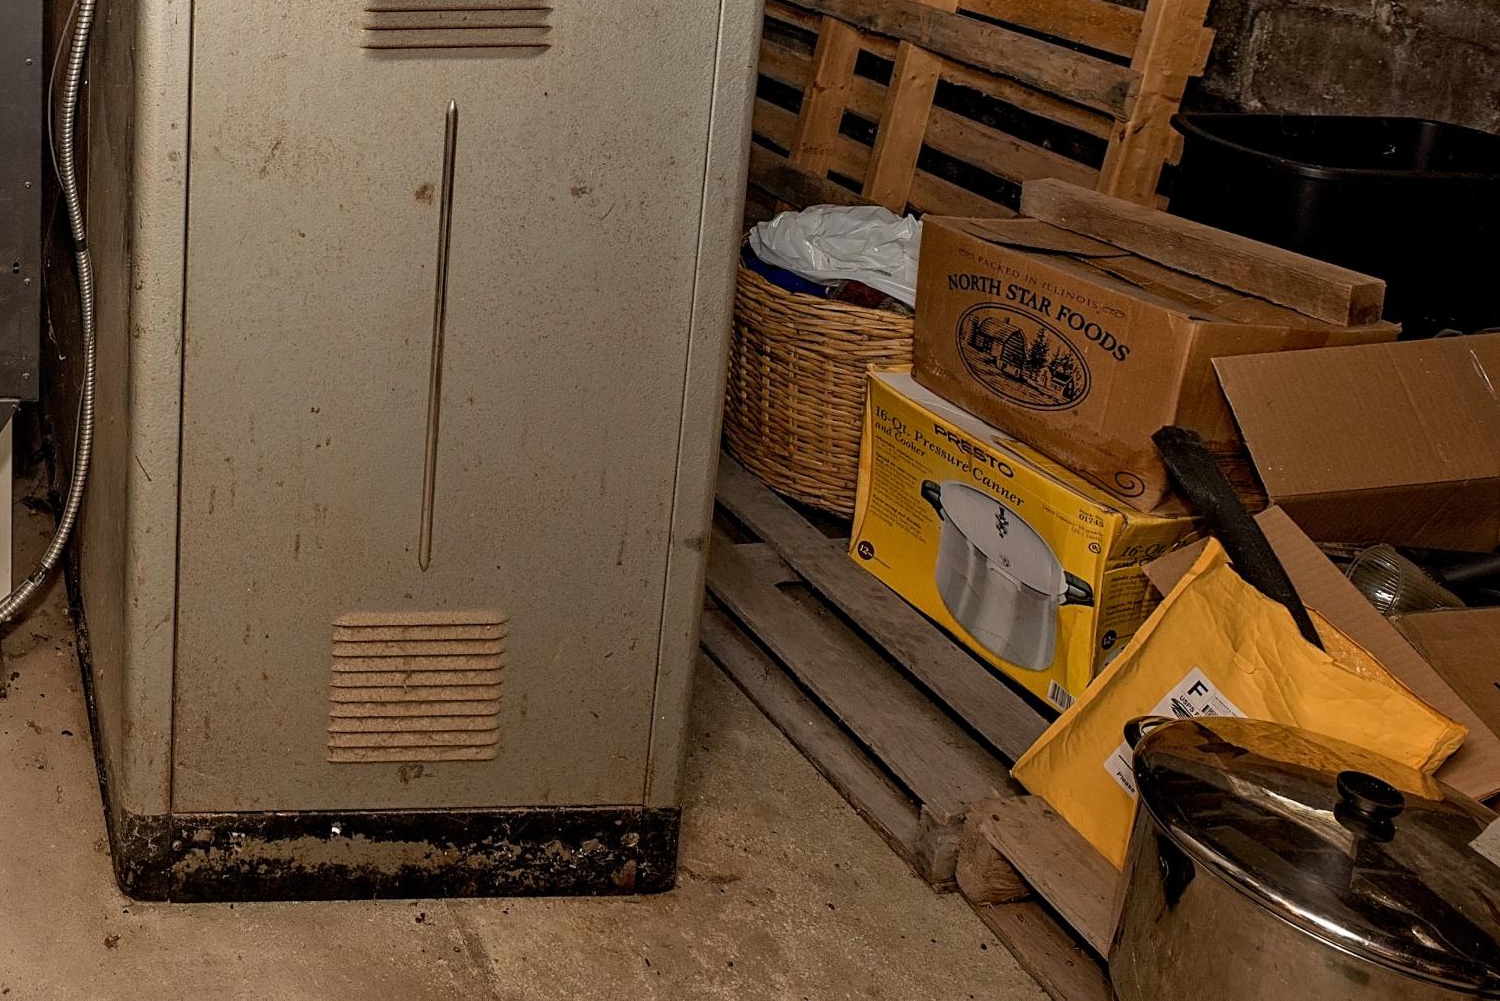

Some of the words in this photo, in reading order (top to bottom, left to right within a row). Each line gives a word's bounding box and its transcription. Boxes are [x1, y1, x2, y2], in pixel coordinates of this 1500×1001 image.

[977, 255, 1020, 280] PACKED
[1024, 274, 1038, 285] IN
[1041, 280, 1099, 309] ILLINOIS
[947, 273, 1002, 297] NORTH
[1005, 283, 1052, 317] STAR
[1055, 304, 1130, 362] FOODS
[875, 421, 891, 436] and
[895, 432, 927, 457] Cooker
[875, 406, 910, 438] 16-Qt.
[914, 430, 969, 473] Pressure
[972, 467, 1025, 508] Canner
[933, 423, 1015, 479] PRESTO
[1078, 513, 1104, 528] 01745
[1179, 695, 1195, 713] USPS
[1187, 680, 1208, 697] F
[1116, 771, 1136, 793] Please
